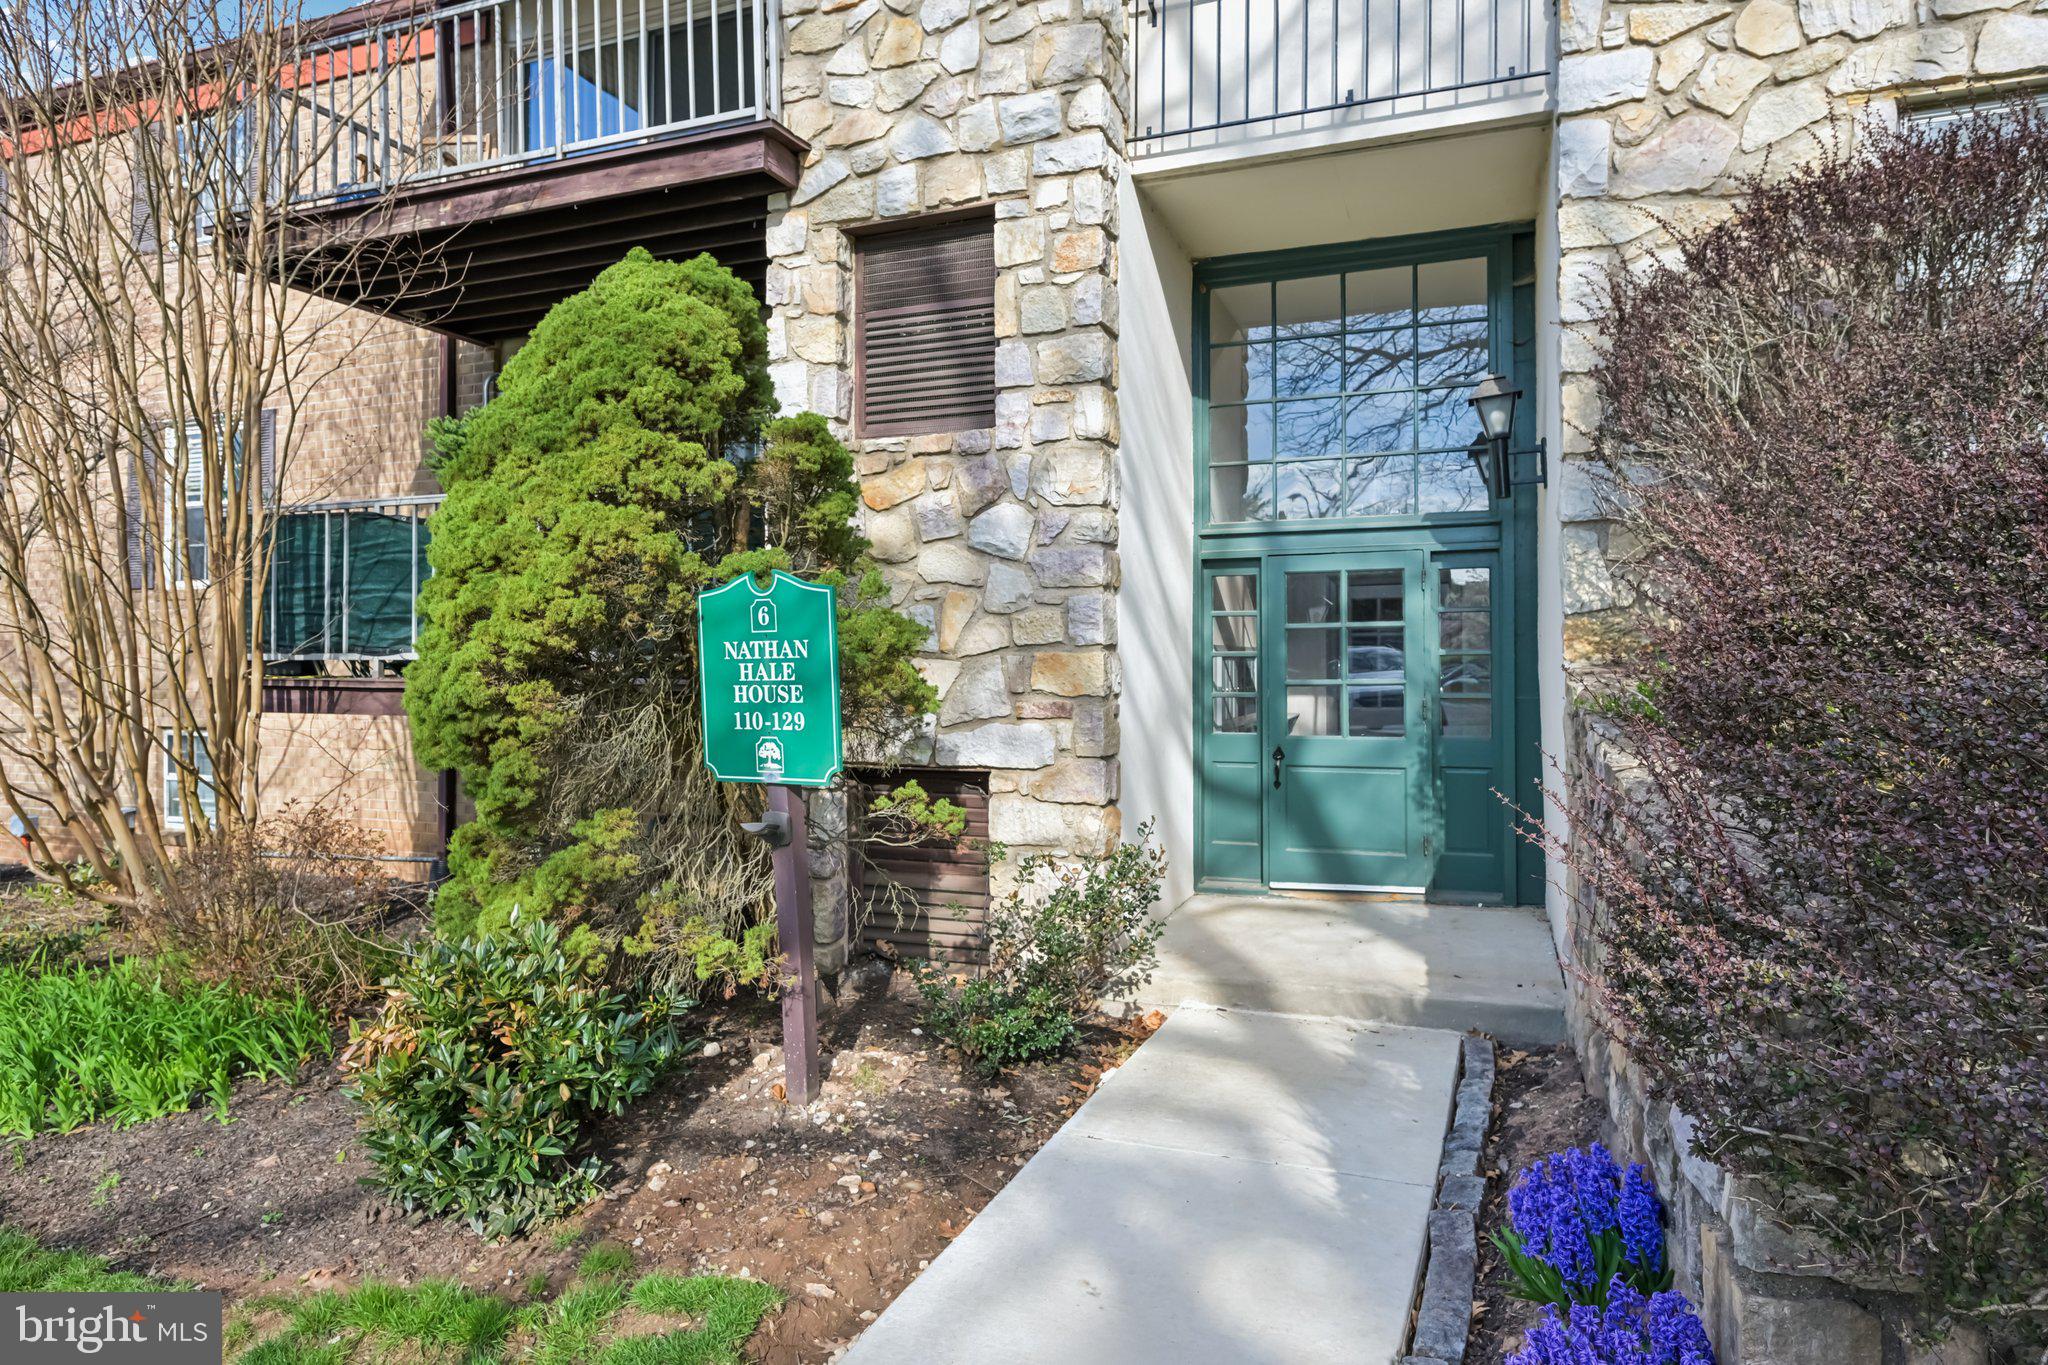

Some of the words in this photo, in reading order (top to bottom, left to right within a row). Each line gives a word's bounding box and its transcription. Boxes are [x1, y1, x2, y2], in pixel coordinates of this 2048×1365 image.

[757, 606, 770, 626] 6
[723, 639, 809, 660] NATHAN
[739, 662, 795, 681] HALE
[733, 685, 804, 704] HOUSE
[734, 711, 805, 731] 110-129
